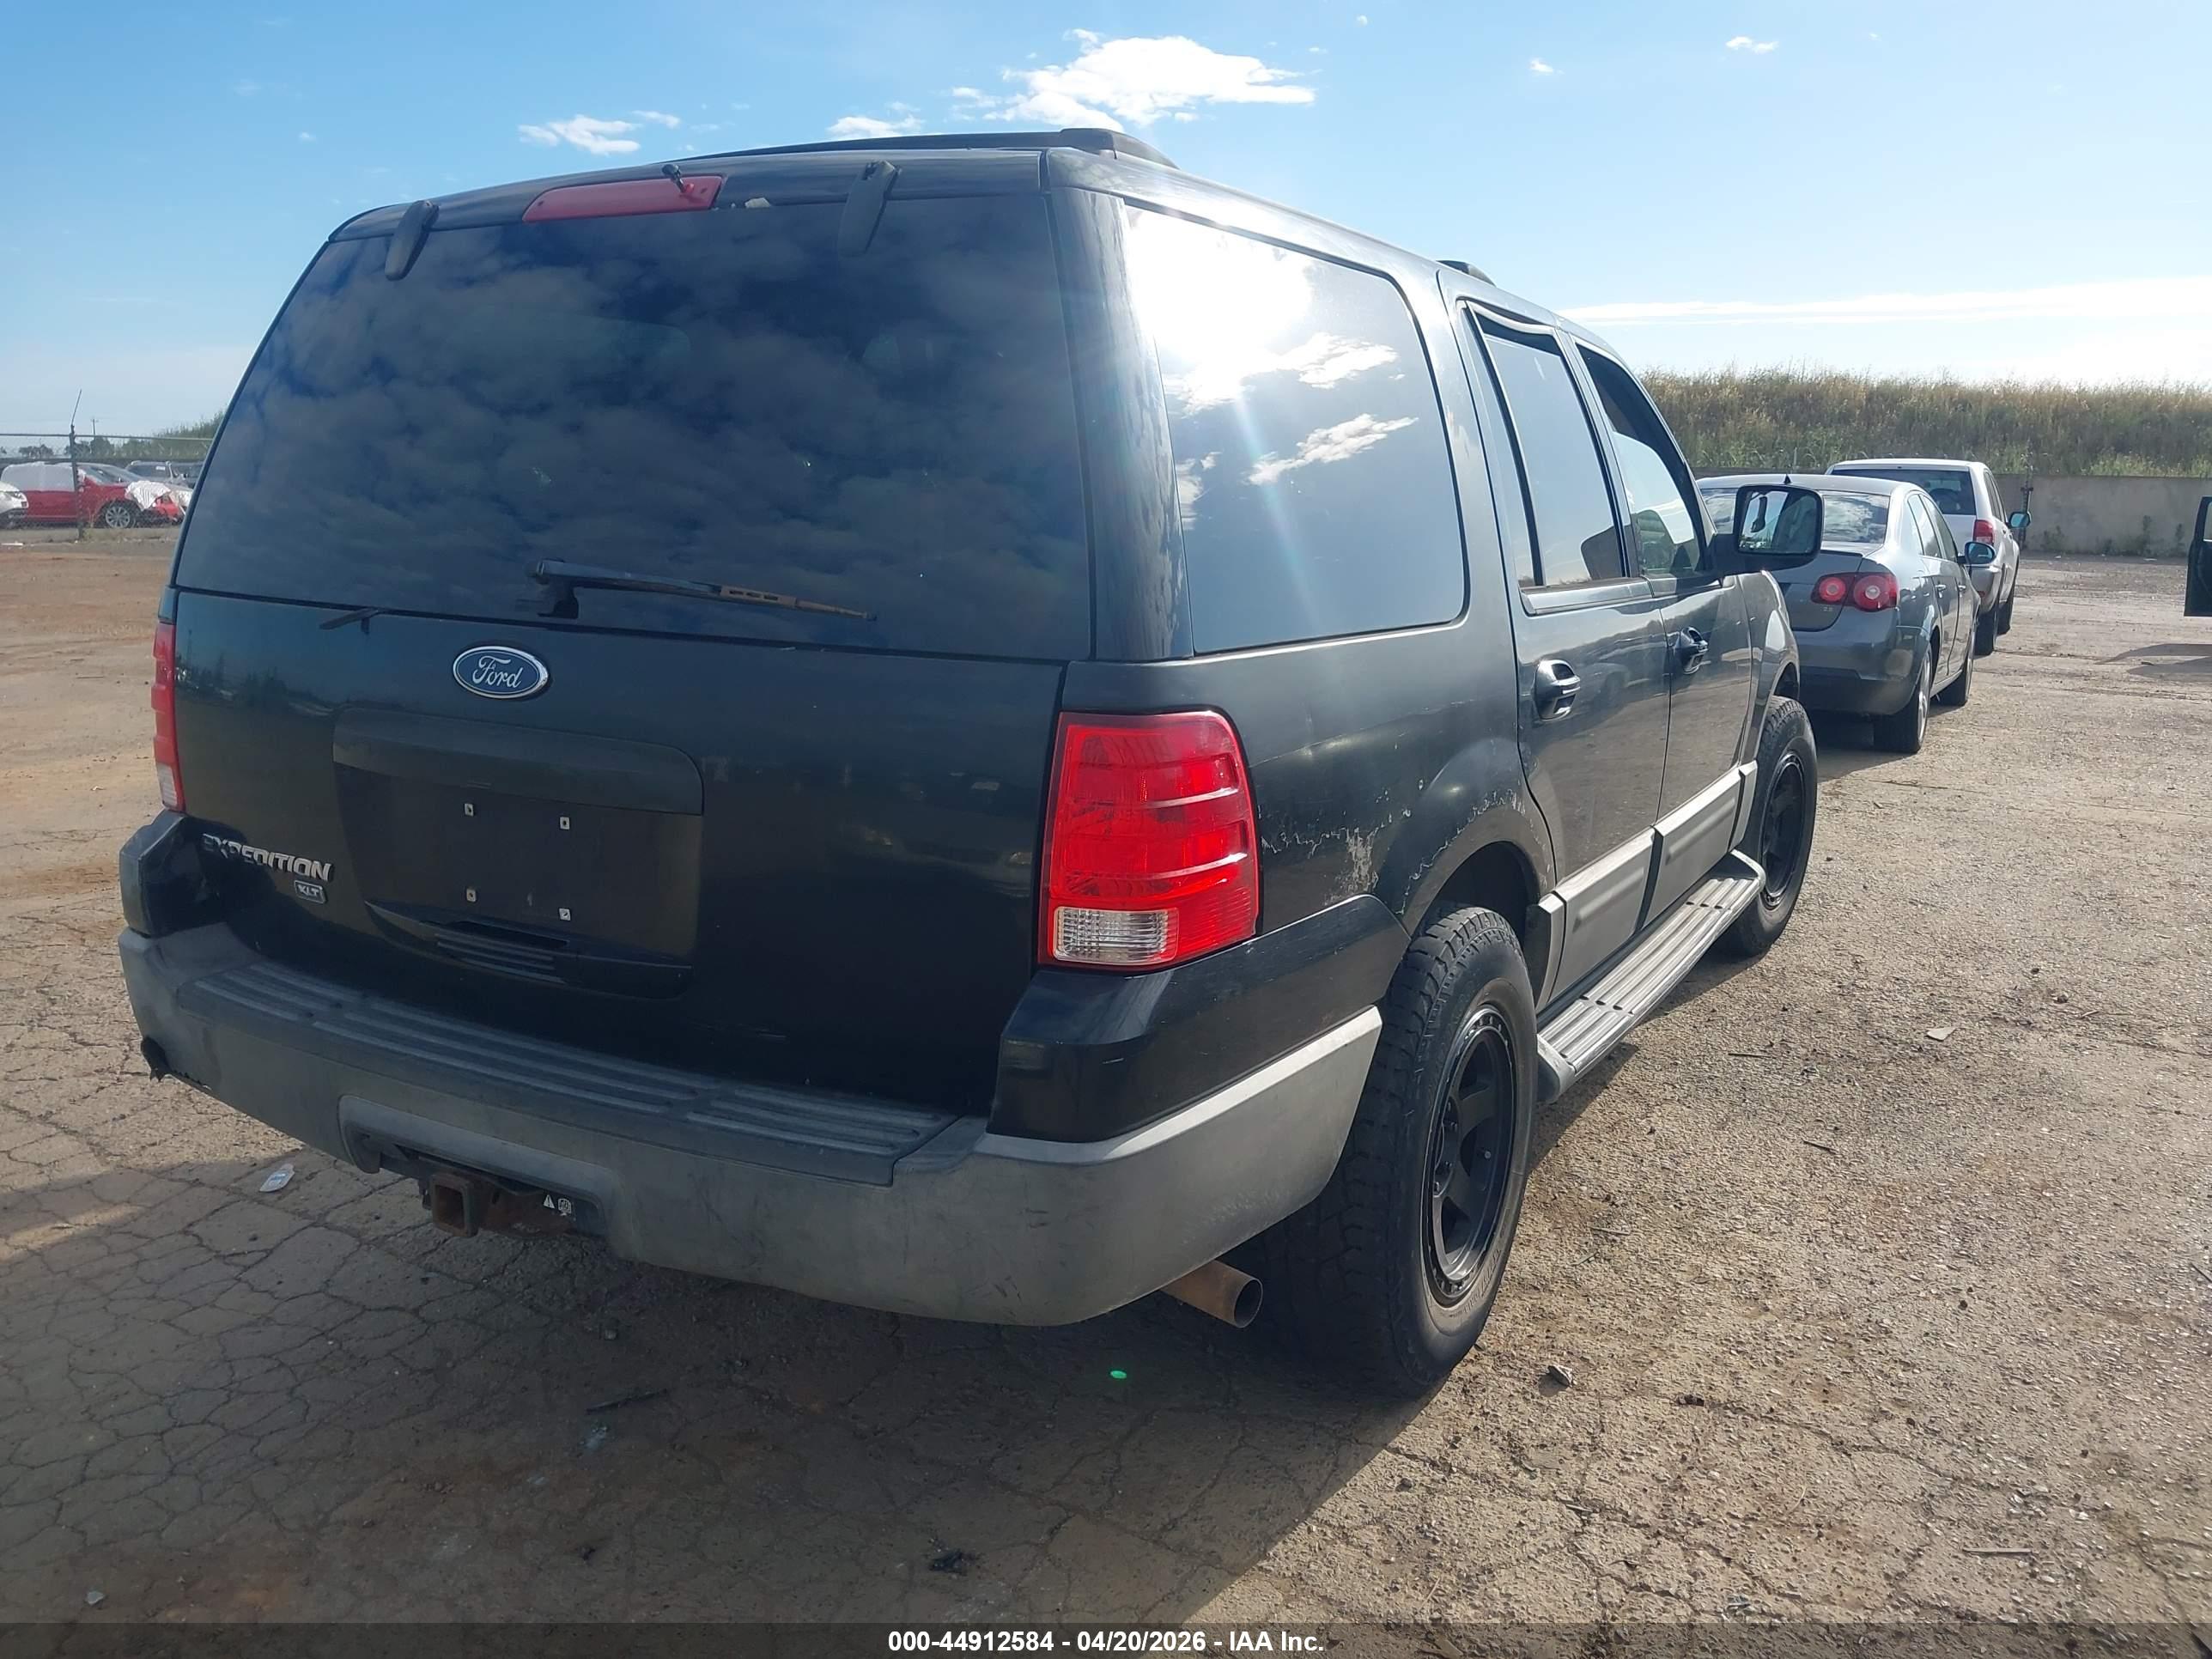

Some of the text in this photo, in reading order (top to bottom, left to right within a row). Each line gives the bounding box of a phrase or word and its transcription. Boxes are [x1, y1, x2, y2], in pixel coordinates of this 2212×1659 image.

[472, 655, 524, 688] Ford
[203, 833, 332, 882] EXPEDITION
[297, 884, 320, 897] XLT
